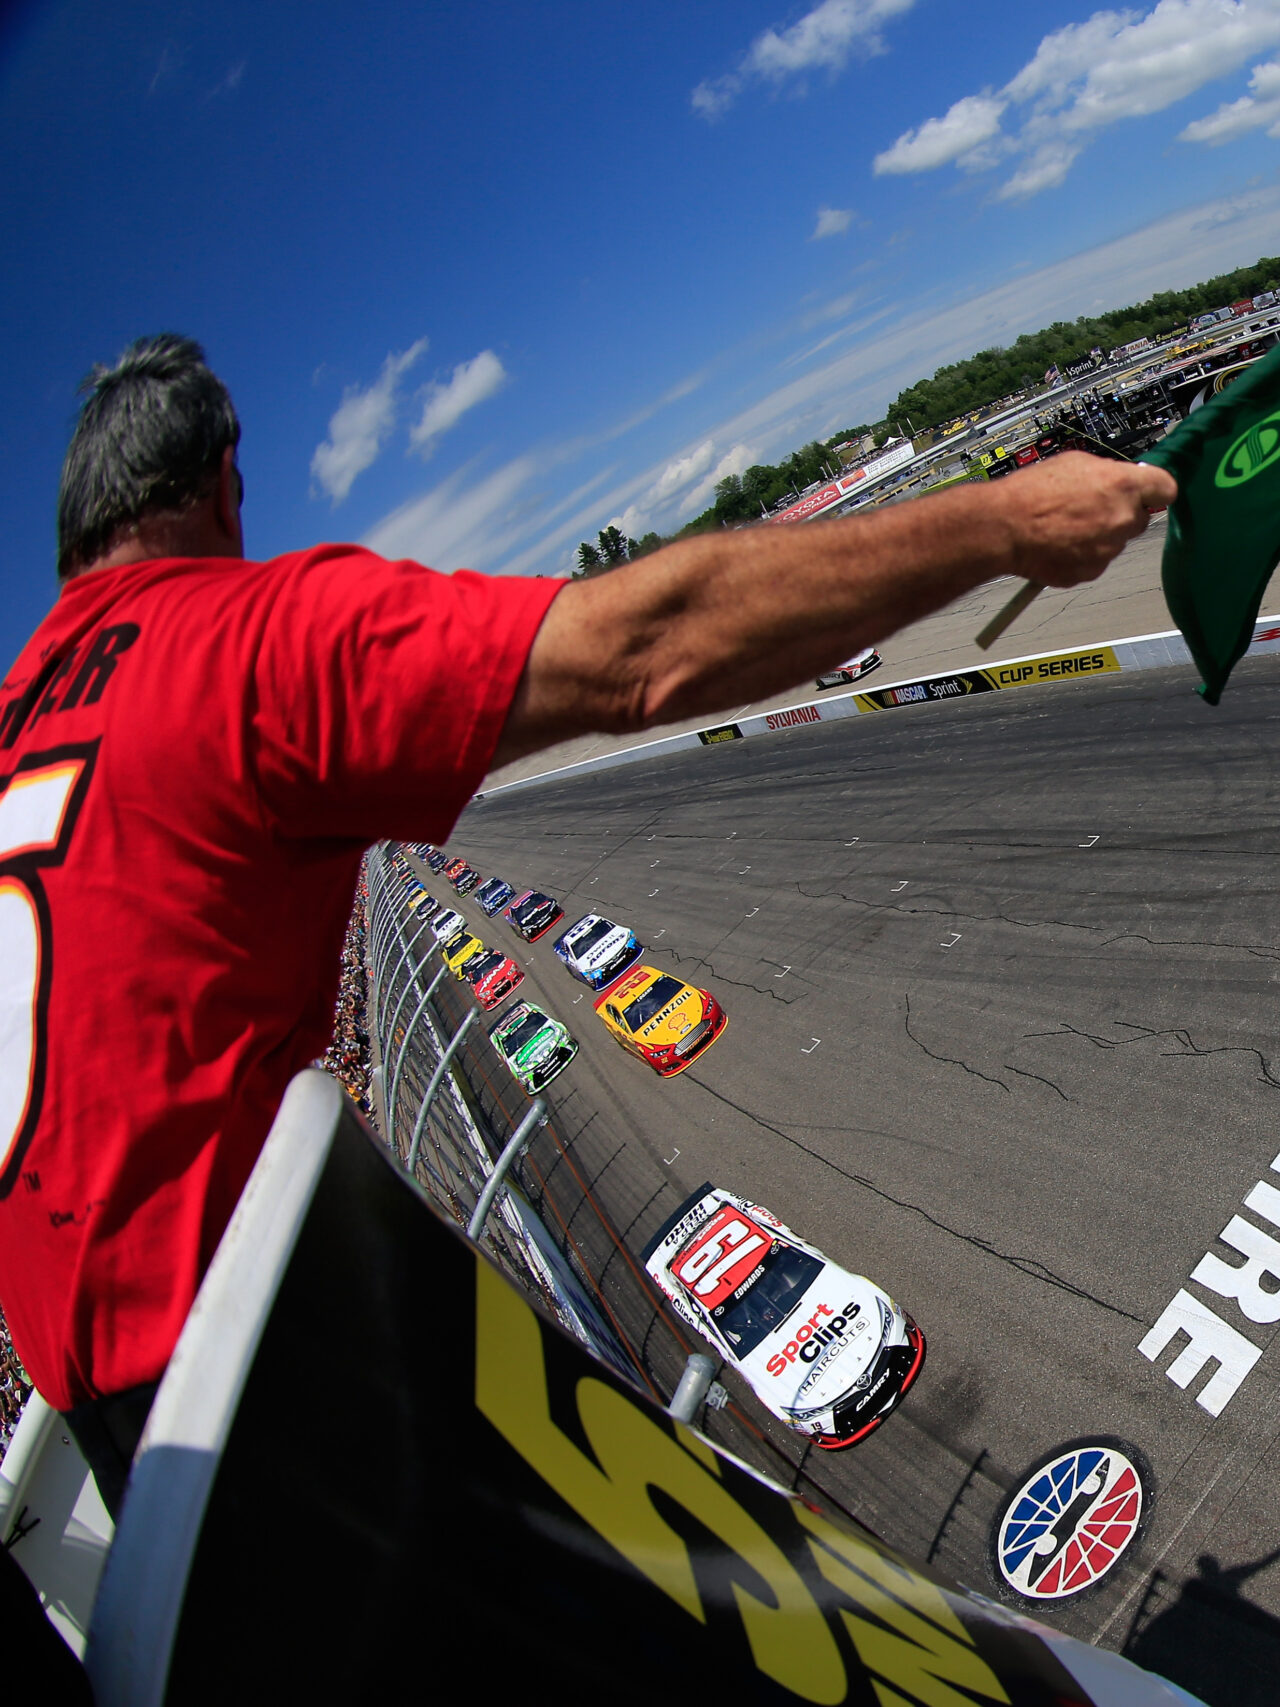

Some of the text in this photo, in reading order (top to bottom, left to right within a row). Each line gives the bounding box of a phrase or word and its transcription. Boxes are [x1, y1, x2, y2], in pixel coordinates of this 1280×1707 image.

[1070, 360, 1094, 375] Sprint
[999, 654, 1105, 685] CUP SERIES
[894, 678, 963, 706] NASCAR Sprint
[765, 706, 822, 731] SYLVANIA
[589, 932, 627, 967] Aaron's
[642, 990, 693, 1037] PENNZOIL
[664, 1202, 705, 1247] HERO
[679, 1218, 768, 1297] 19
[734, 1264, 766, 1300] EDWARDS
[766, 1303, 835, 1377] Sport
[798, 1301, 862, 1364] Clips
[802, 1320, 869, 1392] HAIRCUTS
[855, 1368, 891, 1412] CAMRY
[810, 1421, 823, 1431] 19
